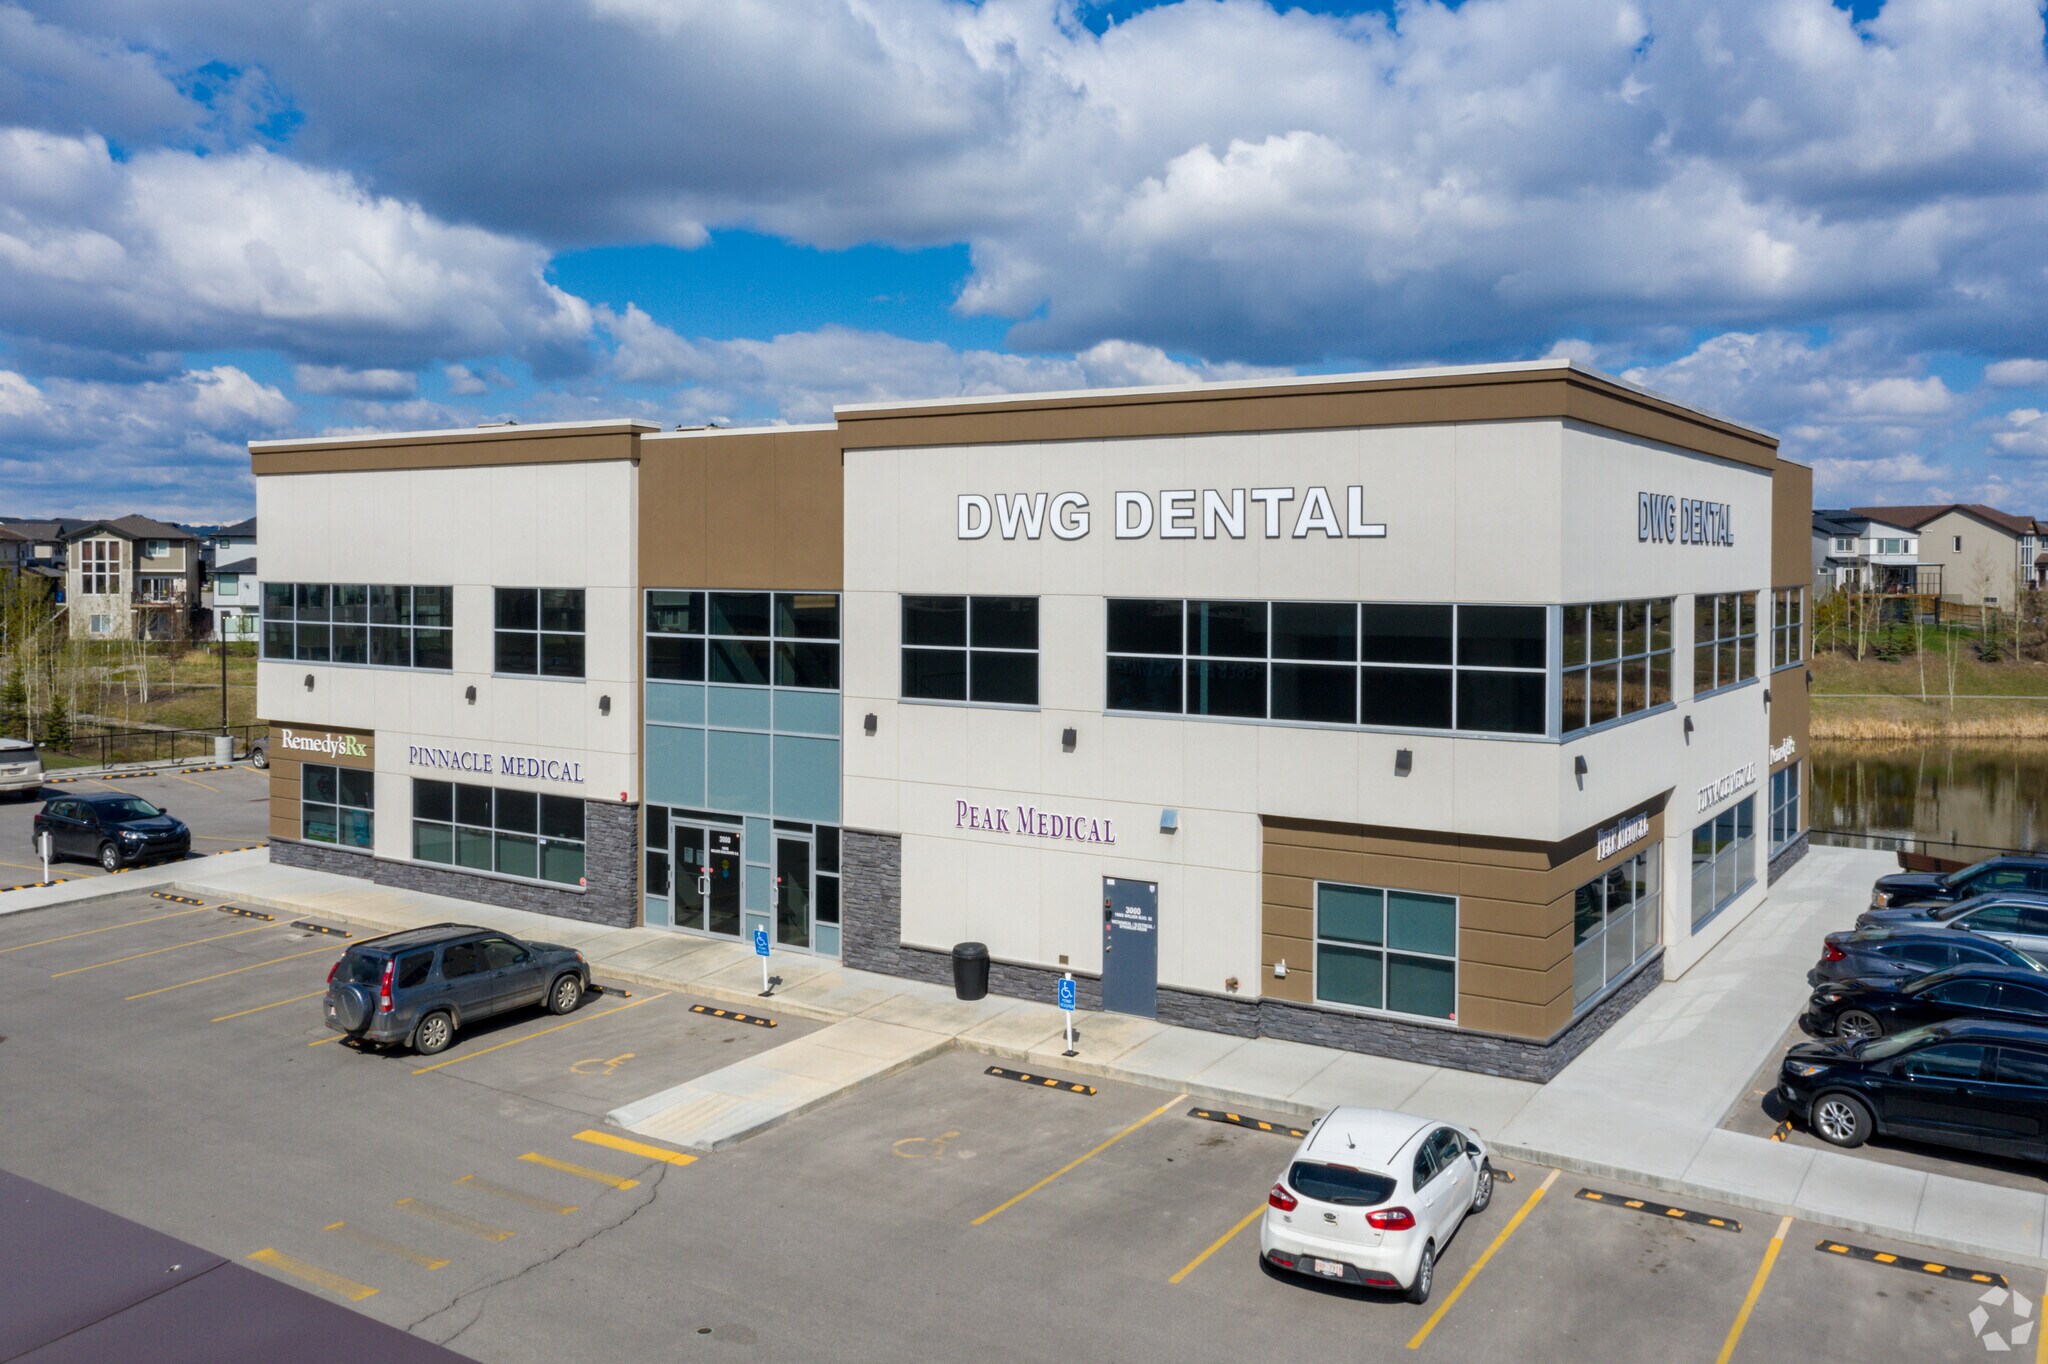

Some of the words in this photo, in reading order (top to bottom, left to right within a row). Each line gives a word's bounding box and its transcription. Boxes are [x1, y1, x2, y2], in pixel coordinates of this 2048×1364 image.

[957, 491, 1091, 541] DWG
[1114, 485, 1387, 539] DENTAL
[1638, 491, 1677, 545] DWG
[1680, 497, 1734, 547] DENTAL
[409, 746, 493, 774] PINNACLE
[500, 755, 585, 784] MEDICAL
[1125, 906, 1141, 915] 3000
